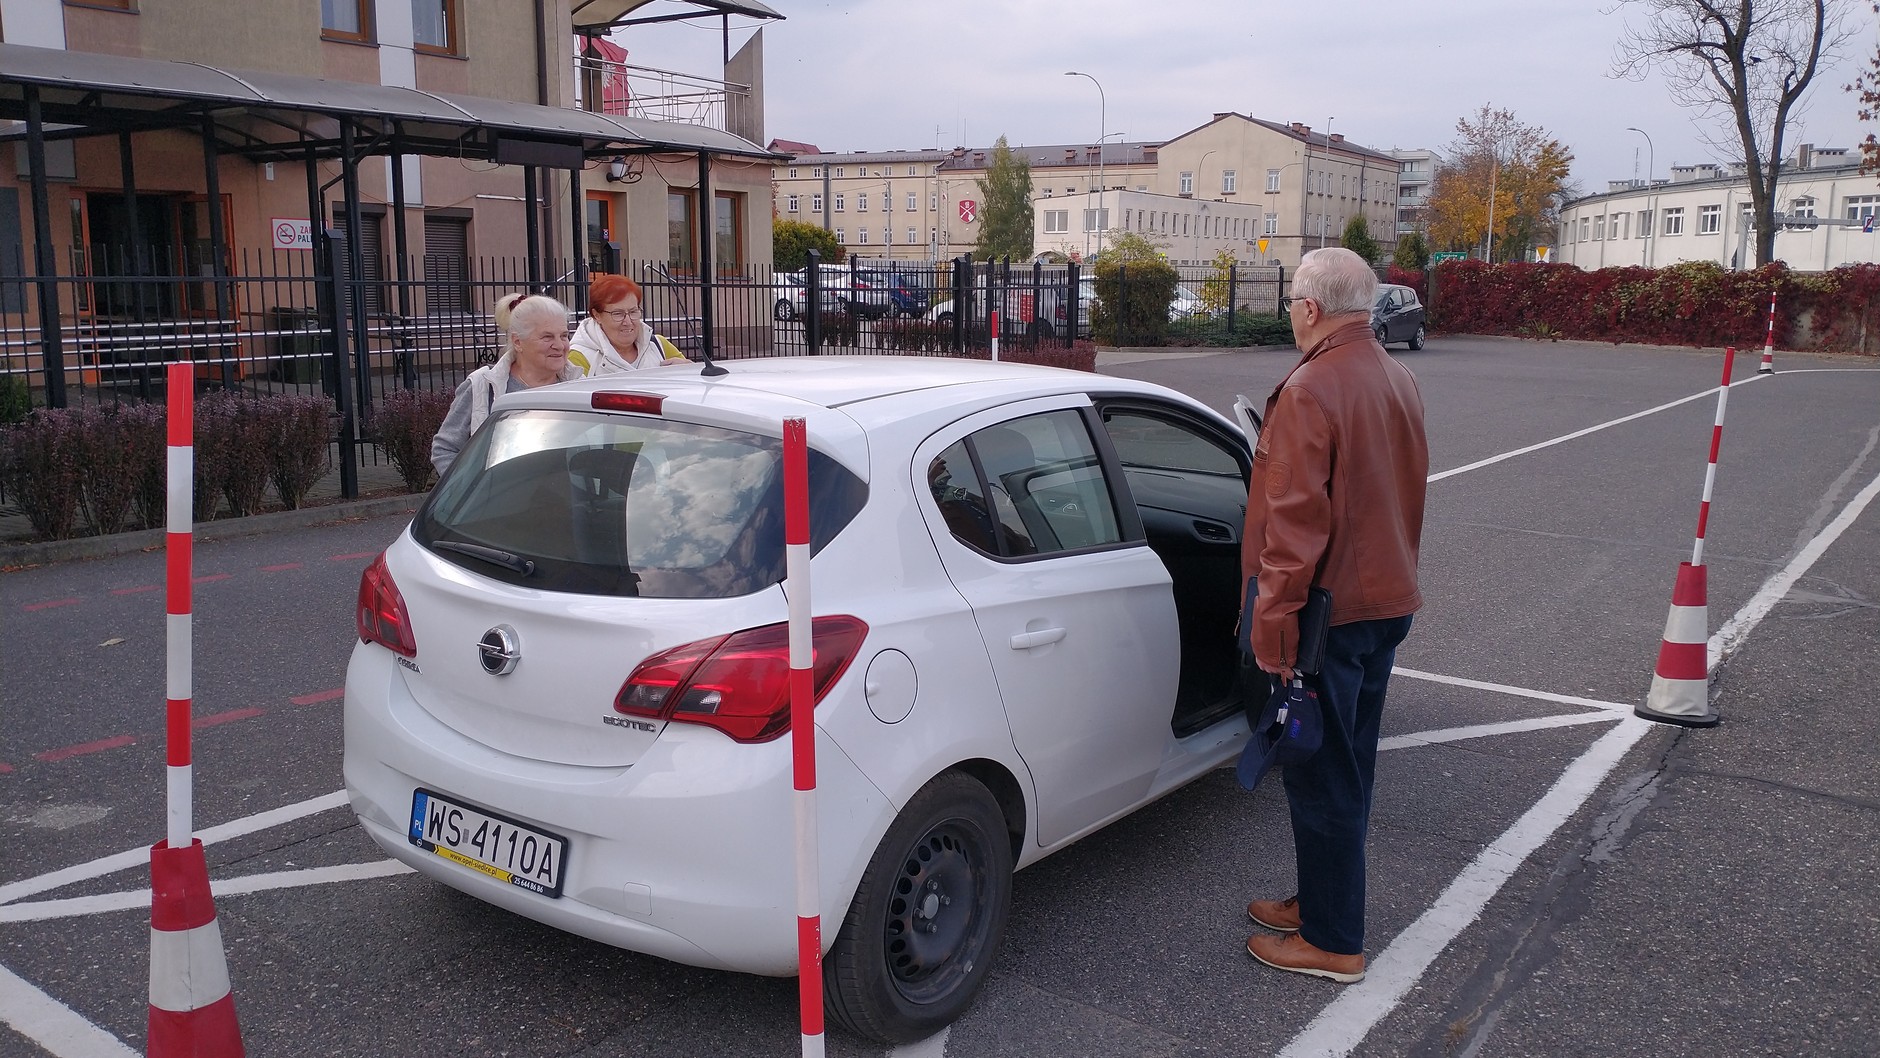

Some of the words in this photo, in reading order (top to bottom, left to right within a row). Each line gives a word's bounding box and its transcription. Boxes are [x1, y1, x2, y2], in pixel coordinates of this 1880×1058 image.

[603, 715, 657, 732] ECOTEC
[414, 819, 423, 831] PL
[429, 801, 464, 846] WS
[471, 820, 552, 883] 4110A
[514, 877, 521, 885] 25
